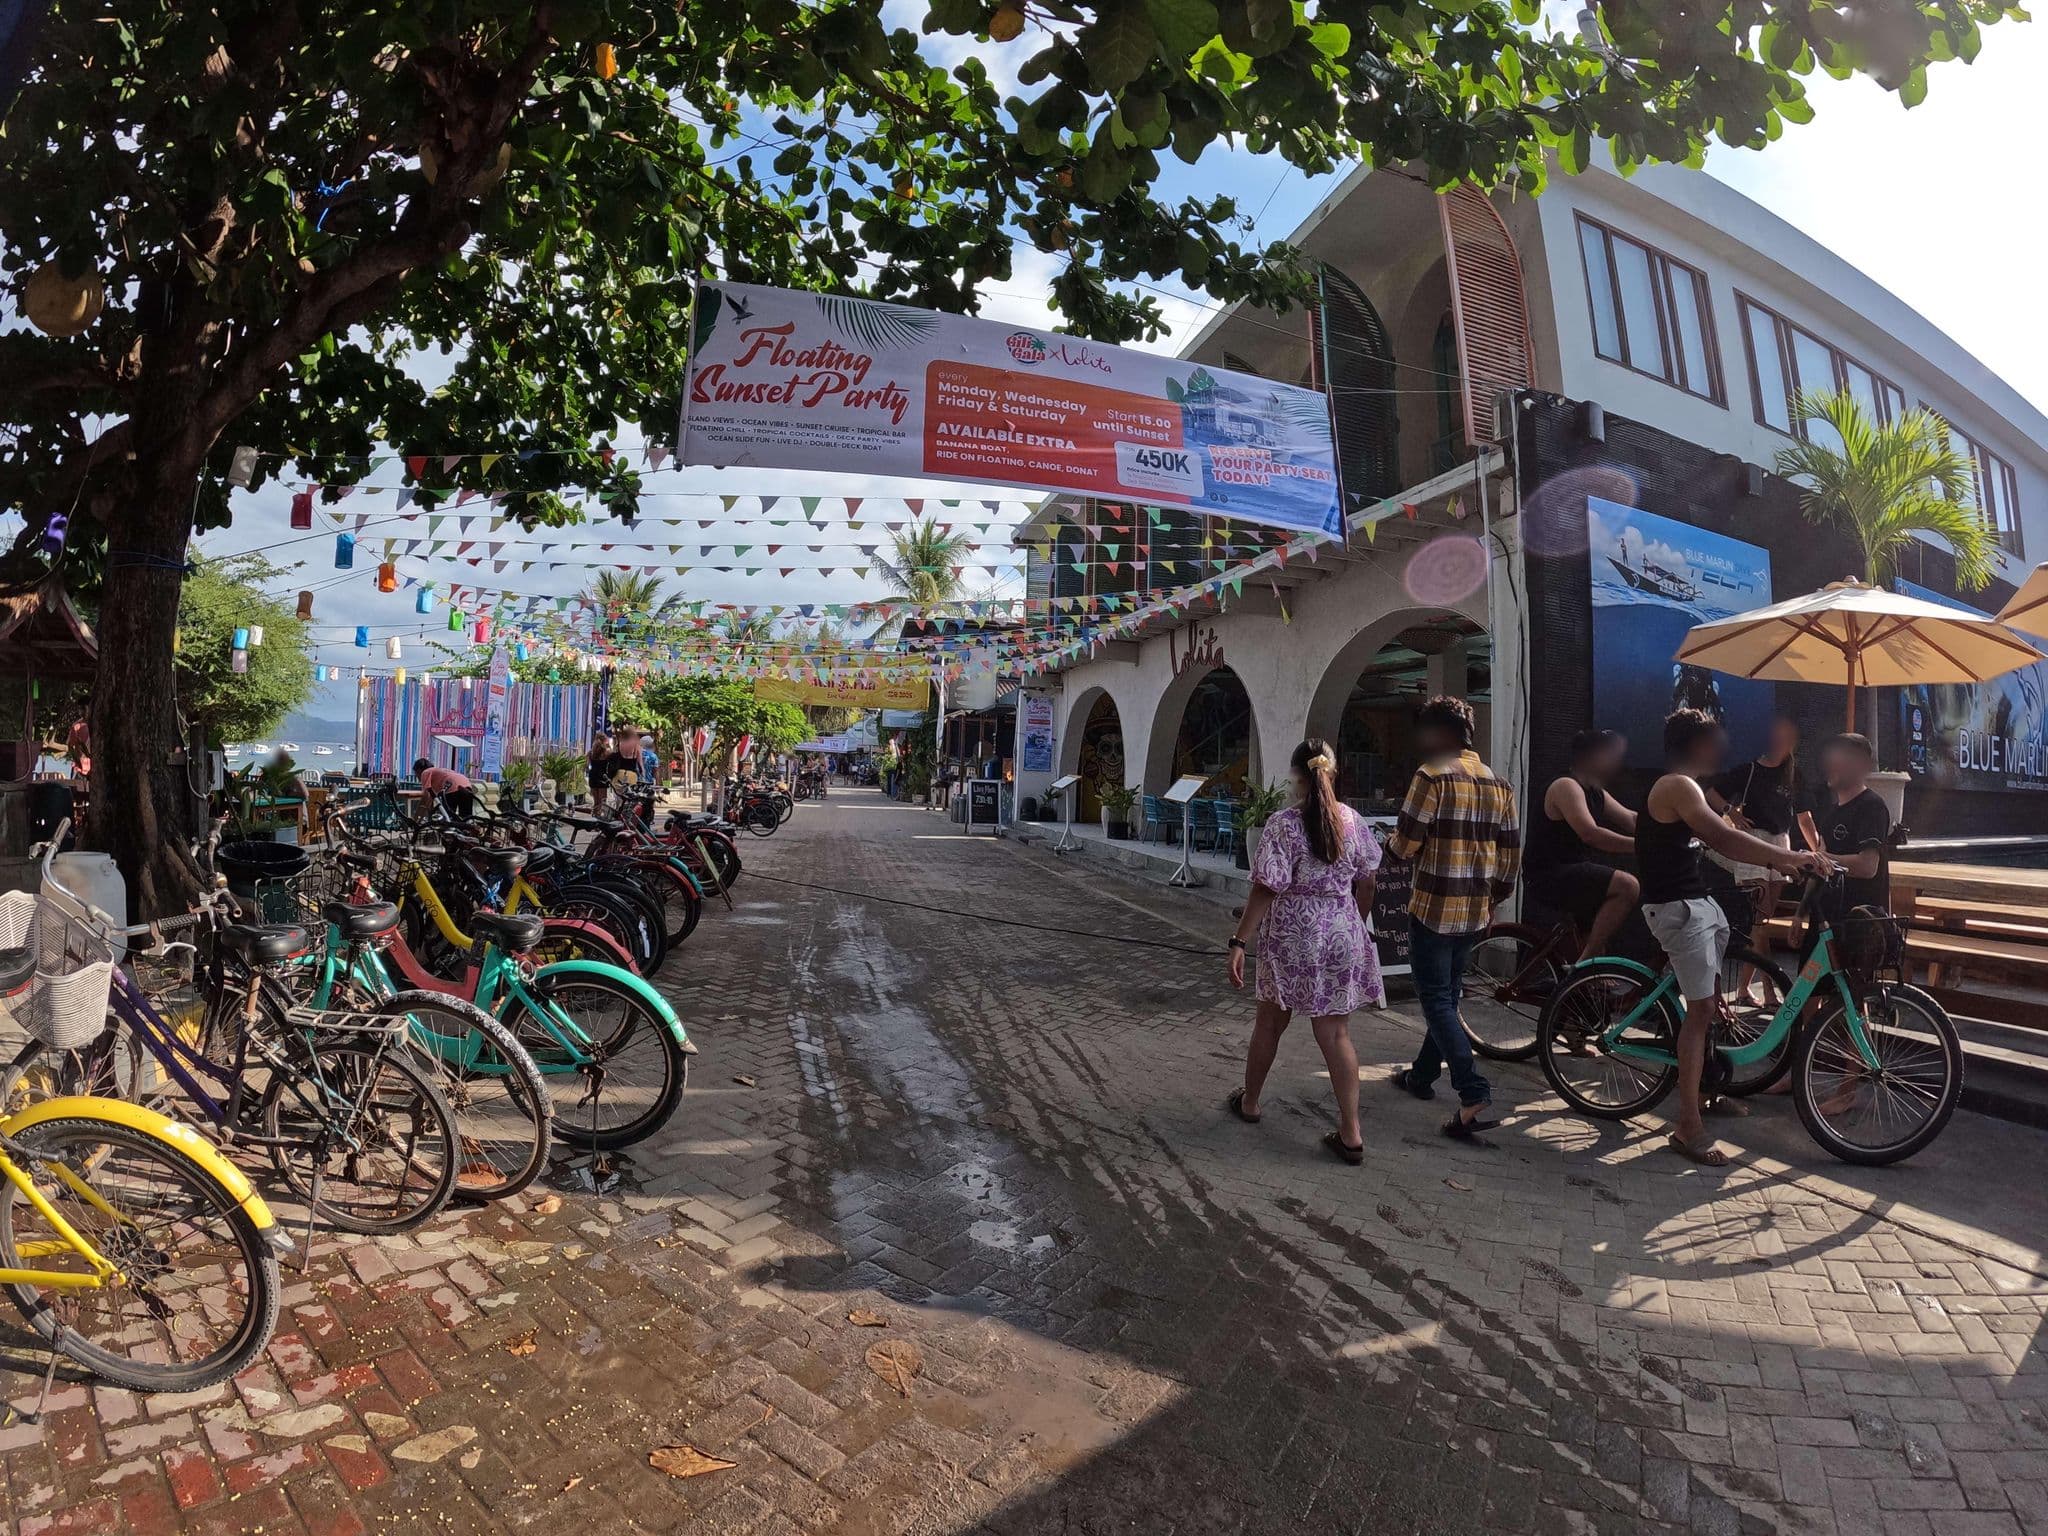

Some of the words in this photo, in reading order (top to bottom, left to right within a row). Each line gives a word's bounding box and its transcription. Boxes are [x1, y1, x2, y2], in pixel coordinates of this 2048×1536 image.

[733, 320, 873, 386] Floating
[1006, 335, 1032, 348] Gili
[1012, 347, 1046, 361] Gala
[1061, 343, 1113, 374] Lolita
[938, 370, 969, 384] every
[691, 364, 815, 404] Sunset
[802, 370, 911, 426] Party
[938, 381, 1001, 401] Monday,
[1005, 391, 1087, 415] Wednesday
[937, 395, 984, 413] Friday
[987, 401, 998, 412] &
[1001, 403, 1067, 424] Saturday
[1107, 408, 1137, 423] Start
[1139, 414, 1172, 429] 15.00
[741, 418, 767, 427] OCEAN
[796, 422, 823, 430] SUNSET
[824, 425, 850, 433] CRUISE
[857, 427, 890, 437] TROPICAL
[753, 428, 787, 436] TROPICAL
[789, 431, 830, 439] COCKTAILS
[936, 422, 1024, 444] AVAILABLE
[1026, 434, 1078, 450] EXTRA
[1093, 421, 1124, 433] until
[1126, 425, 1171, 442] Sunset
[707, 434, 734, 442] OCEAN
[809, 440, 861, 450] DOUBLE-DECK
[862, 444, 882, 452] BOAT
[936, 440, 978, 450] BANANA
[980, 443, 1010, 454] BOAT,
[1210, 446, 1271, 460] RESERVE
[936, 450, 958, 460] RIDE
[960, 452, 976, 462] ON
[977, 454, 1026, 468] FLOATING,
[1028, 460, 1065, 473] CANOE,
[1066, 464, 1099, 477] DONAT
[1136, 449, 1191, 475] 450K
[1213, 457, 1254, 471] YOUR
[1255, 463, 1298, 477] PARTY
[1299, 467, 1331, 480] SEAT
[1213, 469, 1269, 486] TODAY!
[1686, 548, 1705, 563] BLUE
[1706, 554, 1734, 572] MARLIN
[1169, 620, 1224, 681] Lolita
[1959, 730, 2000, 773] BLUE
[1782, 996, 1802, 1021] ofo
